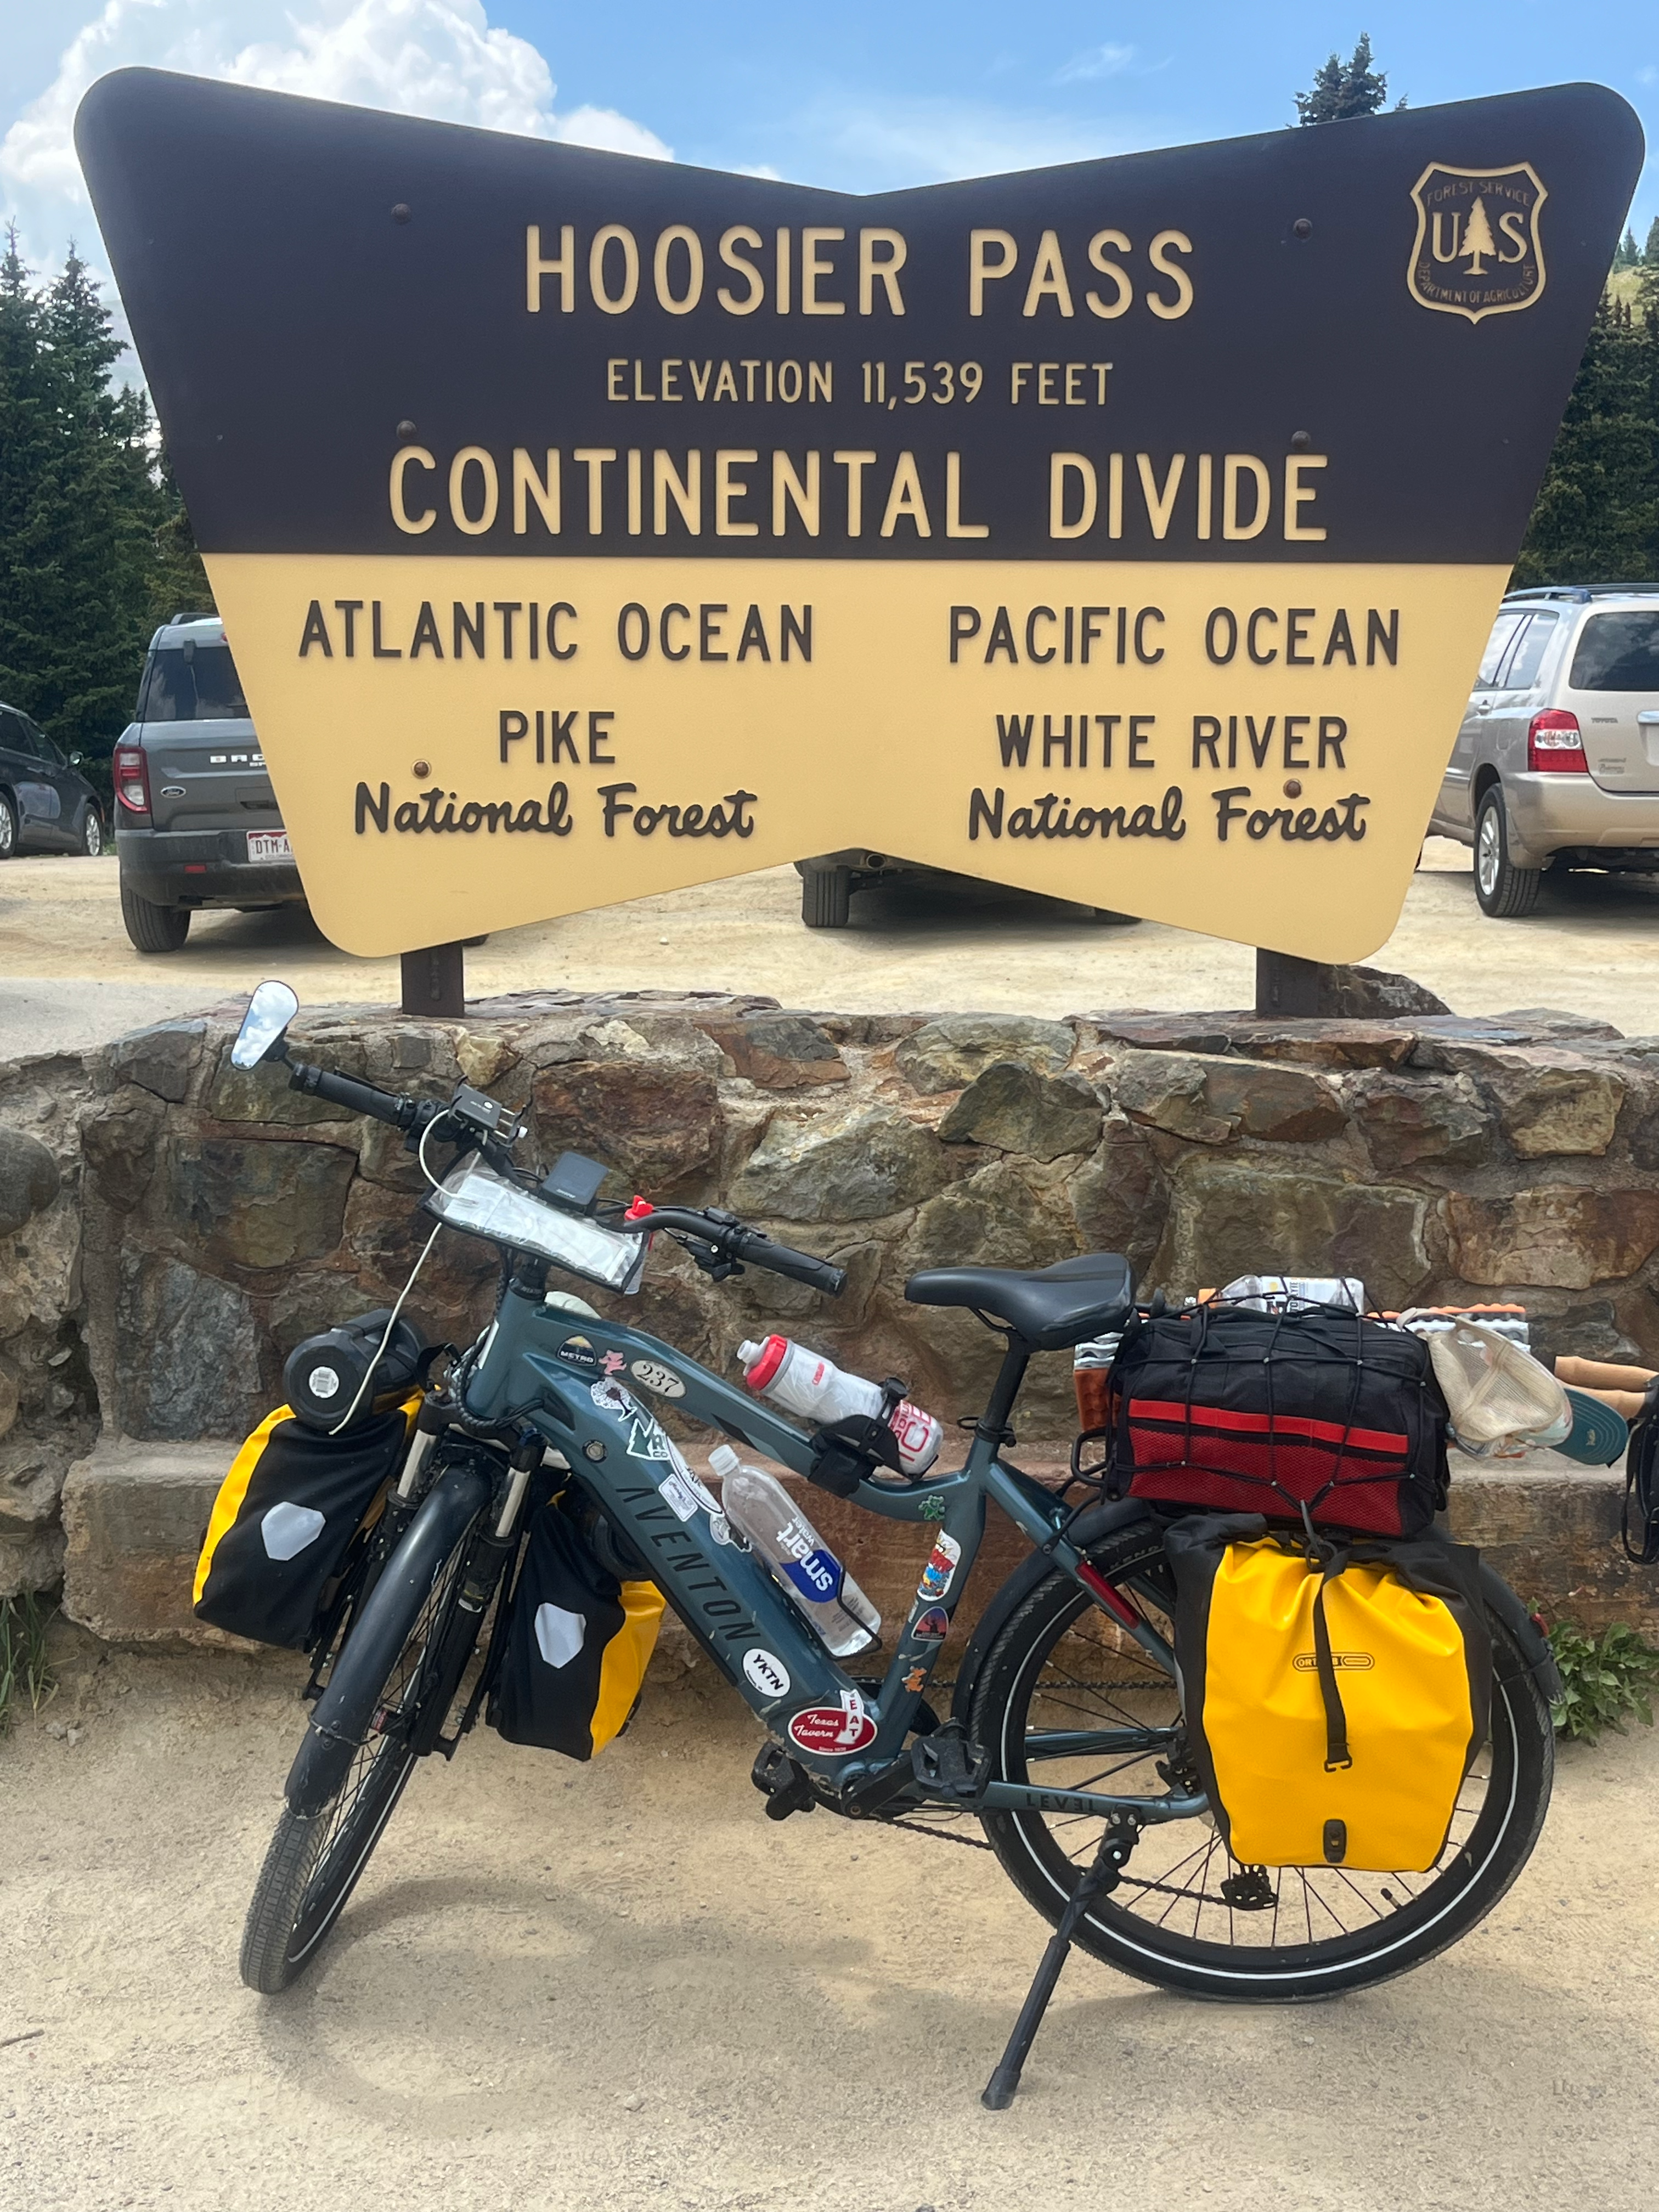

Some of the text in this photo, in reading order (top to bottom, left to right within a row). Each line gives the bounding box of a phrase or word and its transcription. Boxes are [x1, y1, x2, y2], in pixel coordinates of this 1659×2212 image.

[1427, 180, 1530, 207] FOREST SERVICE
[526, 224, 1193, 319] HOOSIER PASS
[1419, 261, 1535, 303] DEPARTMENT OF AGRICULTURE
[607, 358, 1114, 410] ELEVATION 11,539 FEET
[389, 446, 1328, 541] CONTINENTAL DIVIDE
[298, 599, 812, 663] ATLANTIC OCEAN
[950, 605, 1399, 667] PACIFIC OCEAN
[499, 709, 616, 765] PIKE
[996, 714, 1347, 769] WHITE RIVER
[354, 781, 758, 839] National Forest
[968, 786, 1372, 842] National Forest
[636, 1364, 680, 1393] 237
[776, 1521, 833, 1592] smart
[792, 1516, 816, 1547] water
[616, 1487, 761, 1641] AVENTON
[753, 1654, 784, 1690] YKTN
[1298, 1657, 1339, 1667] ORTB
[794, 1724, 834, 1737] Tavern
[807, 1713, 839, 1726] Texas
[849, 1699, 860, 1737] EAT
